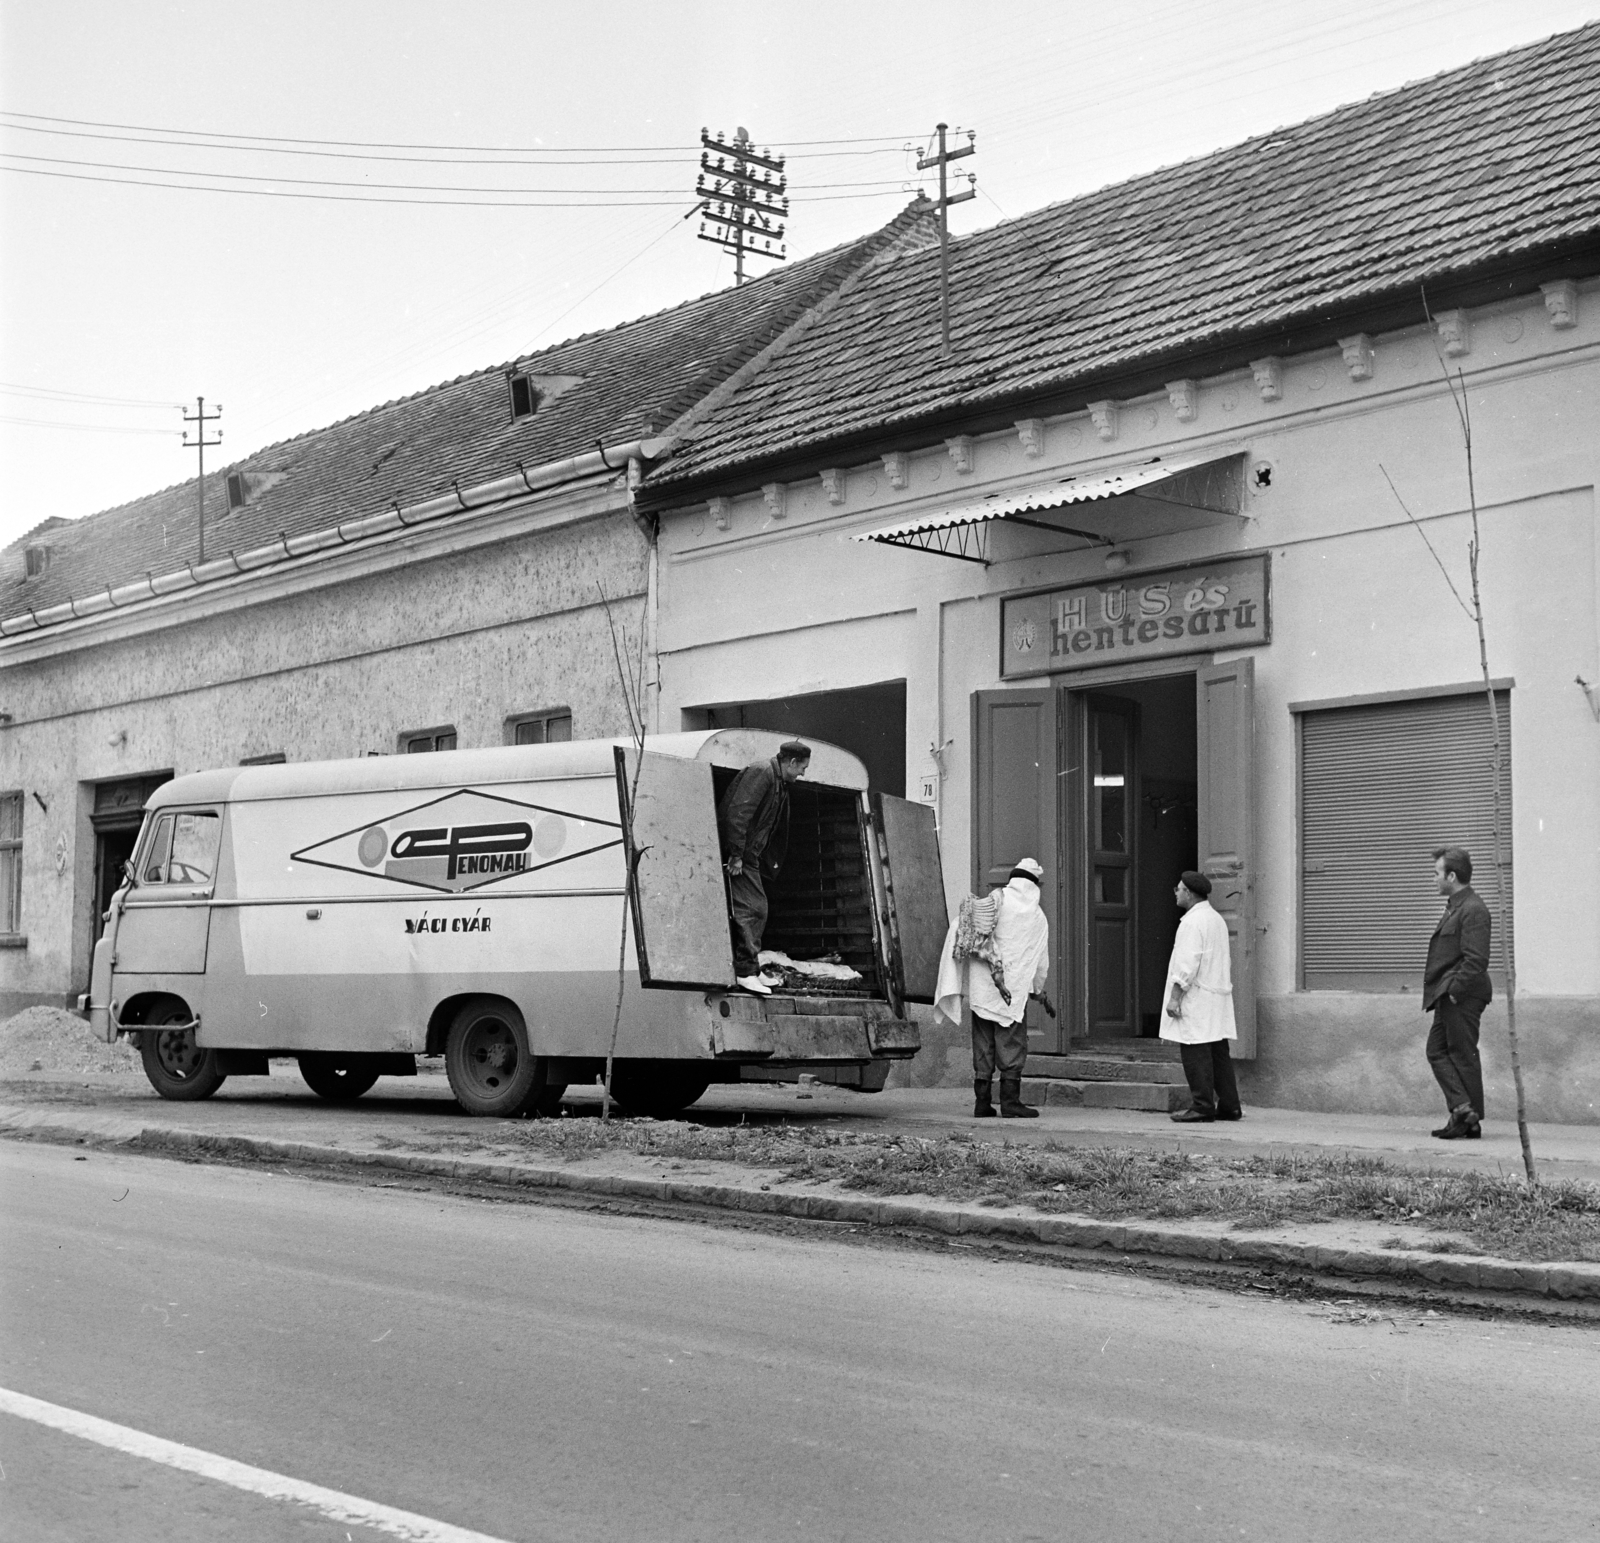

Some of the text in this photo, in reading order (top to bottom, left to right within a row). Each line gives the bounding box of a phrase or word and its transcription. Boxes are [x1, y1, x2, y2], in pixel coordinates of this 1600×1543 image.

[1183, 577, 1230, 612] és
[924, 784, 933, 797] 78
[405, 907, 491, 934] VÁCI GYÁR
